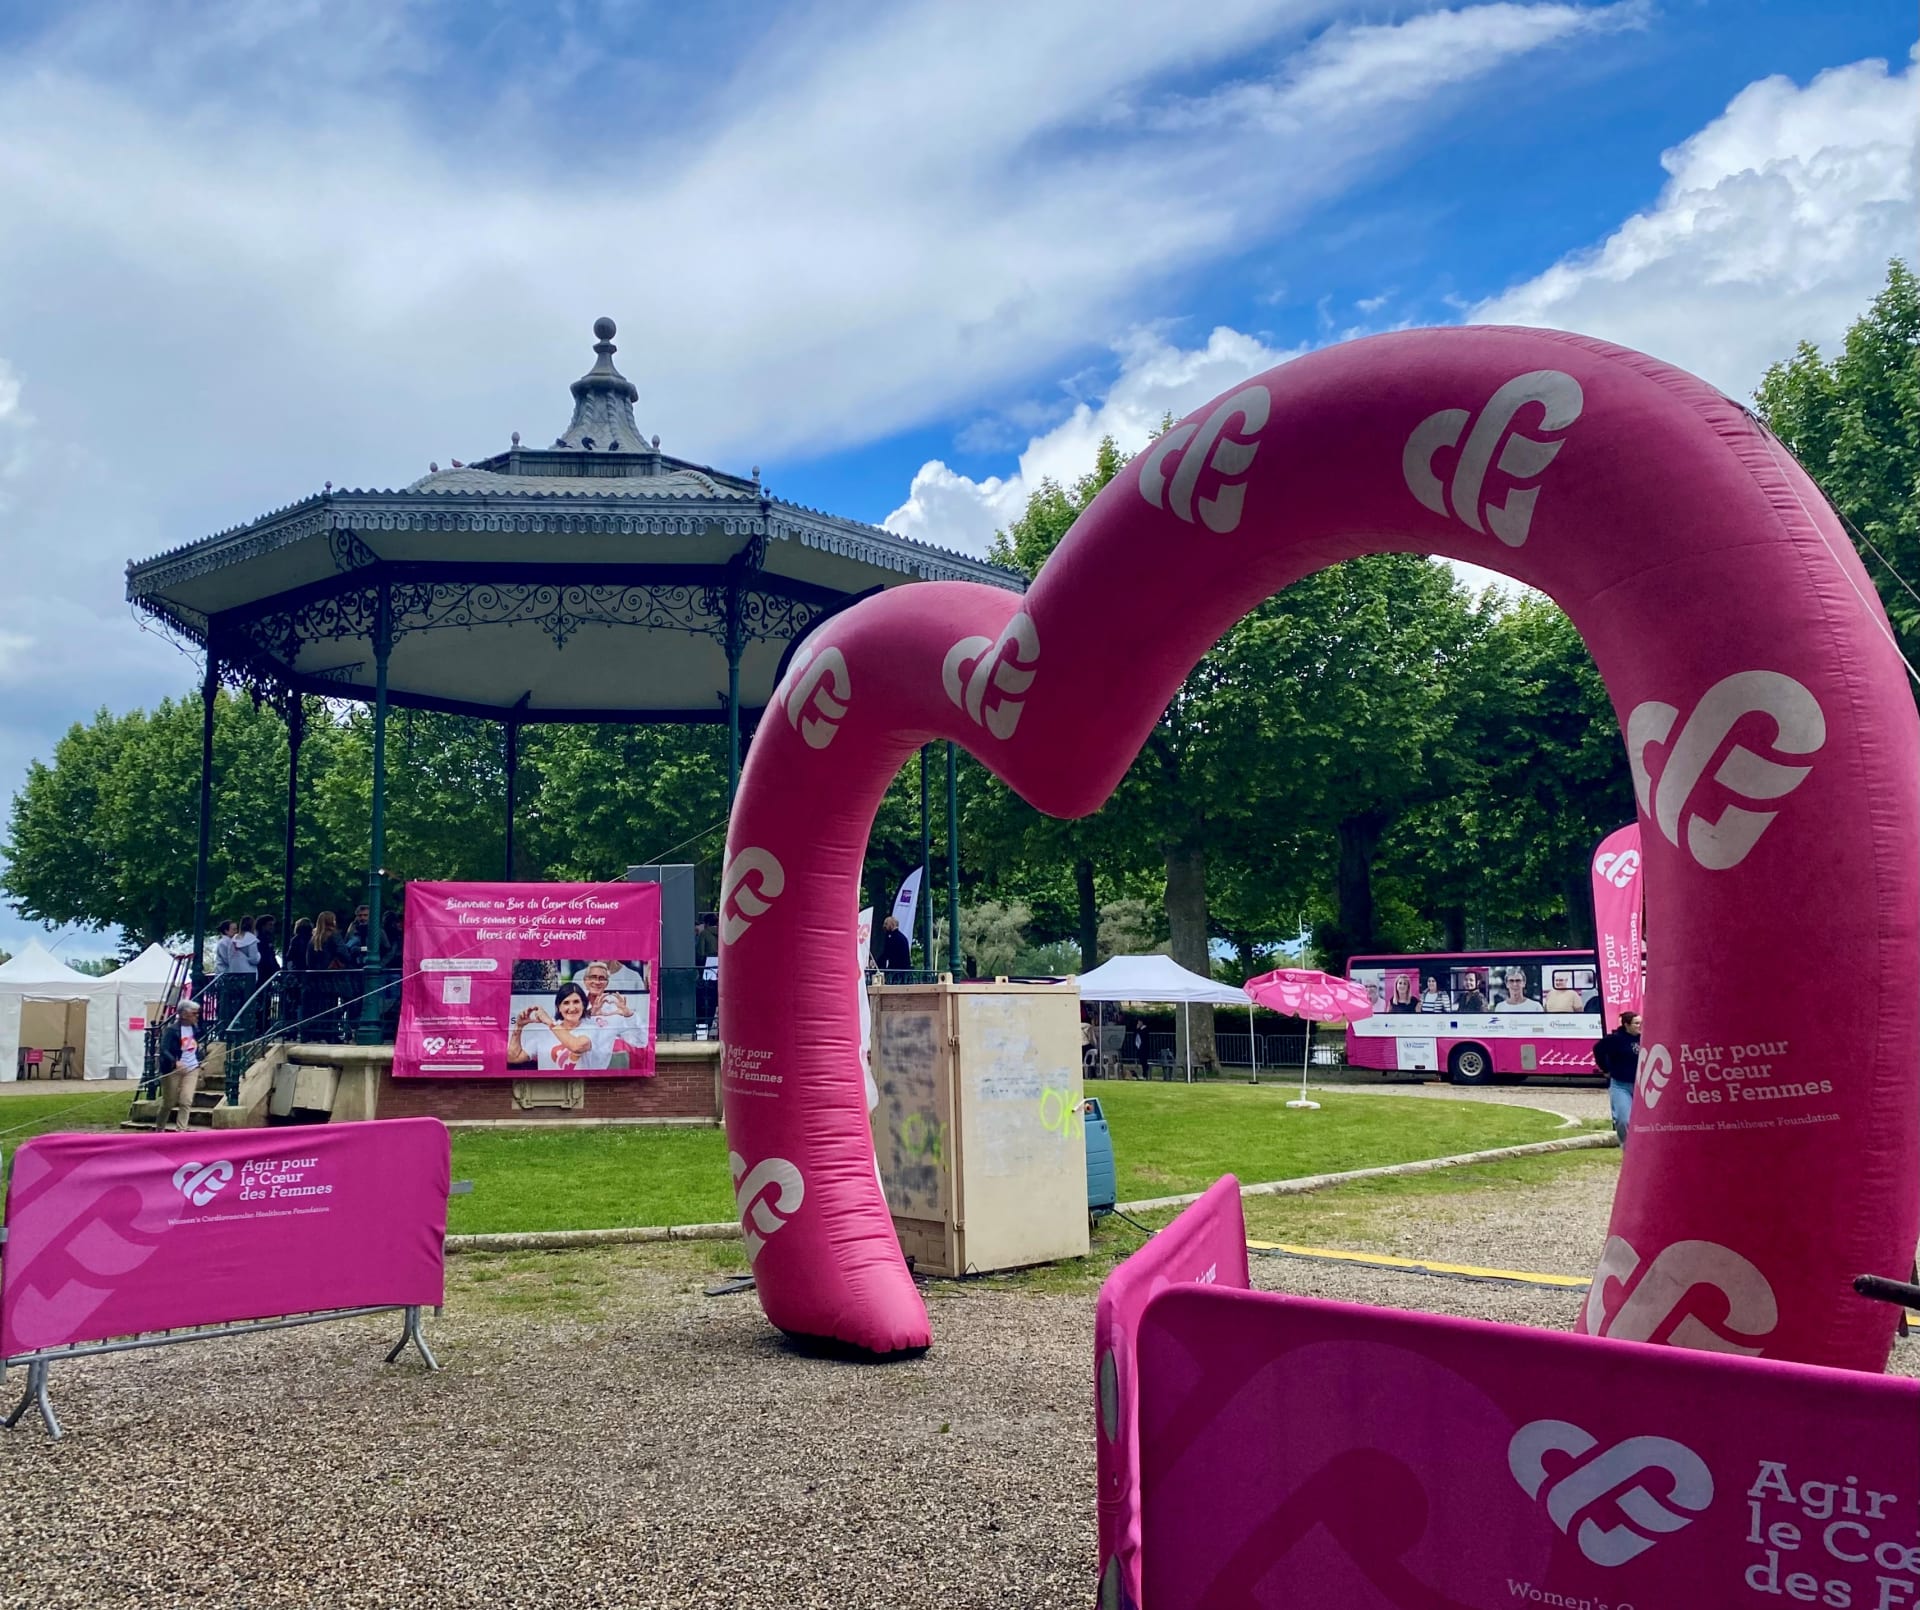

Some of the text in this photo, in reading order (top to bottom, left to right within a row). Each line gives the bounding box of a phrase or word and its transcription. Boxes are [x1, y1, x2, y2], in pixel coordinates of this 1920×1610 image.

[446, 898, 491, 910] Bienvenue
[494, 901, 504, 909] au
[506, 897, 524, 910] Bus
[527, 899, 538, 909] du
[569, 898, 583, 909] des
[583, 896, 618, 909] Femmes
[459, 913, 605, 929] Nous sommes ici grâce à vos dons
[477, 928, 587, 947] Merci de votre générosité
[1605, 933, 1622, 1005] Agir pour
[1620, 945, 1631, 1004] le Cœur
[728, 1044, 774, 1060] Agir pour
[1680, 1041, 1789, 1065] Agir pour
[735, 1057, 762, 1069] Cœur
[740, 1069, 783, 1084] Femmes
[1681, 1063, 1772, 1083] le Cœur
[1686, 1079, 1833, 1104] des Femmes
[1040, 1087, 1081, 1140] OK
[1717, 1119, 1775, 1131] Healthcare
[1776, 1112, 1840, 1126] Foundation
[241, 1157, 319, 1174] Agir pour
[240, 1172, 304, 1186] le Cœur
[240, 1184, 333, 1201] des Femmes
[1747, 1459, 1898, 1520] Agir
[1746, 1500, 1801, 1551] le
[1744, 1549, 1920, 1610] des F
